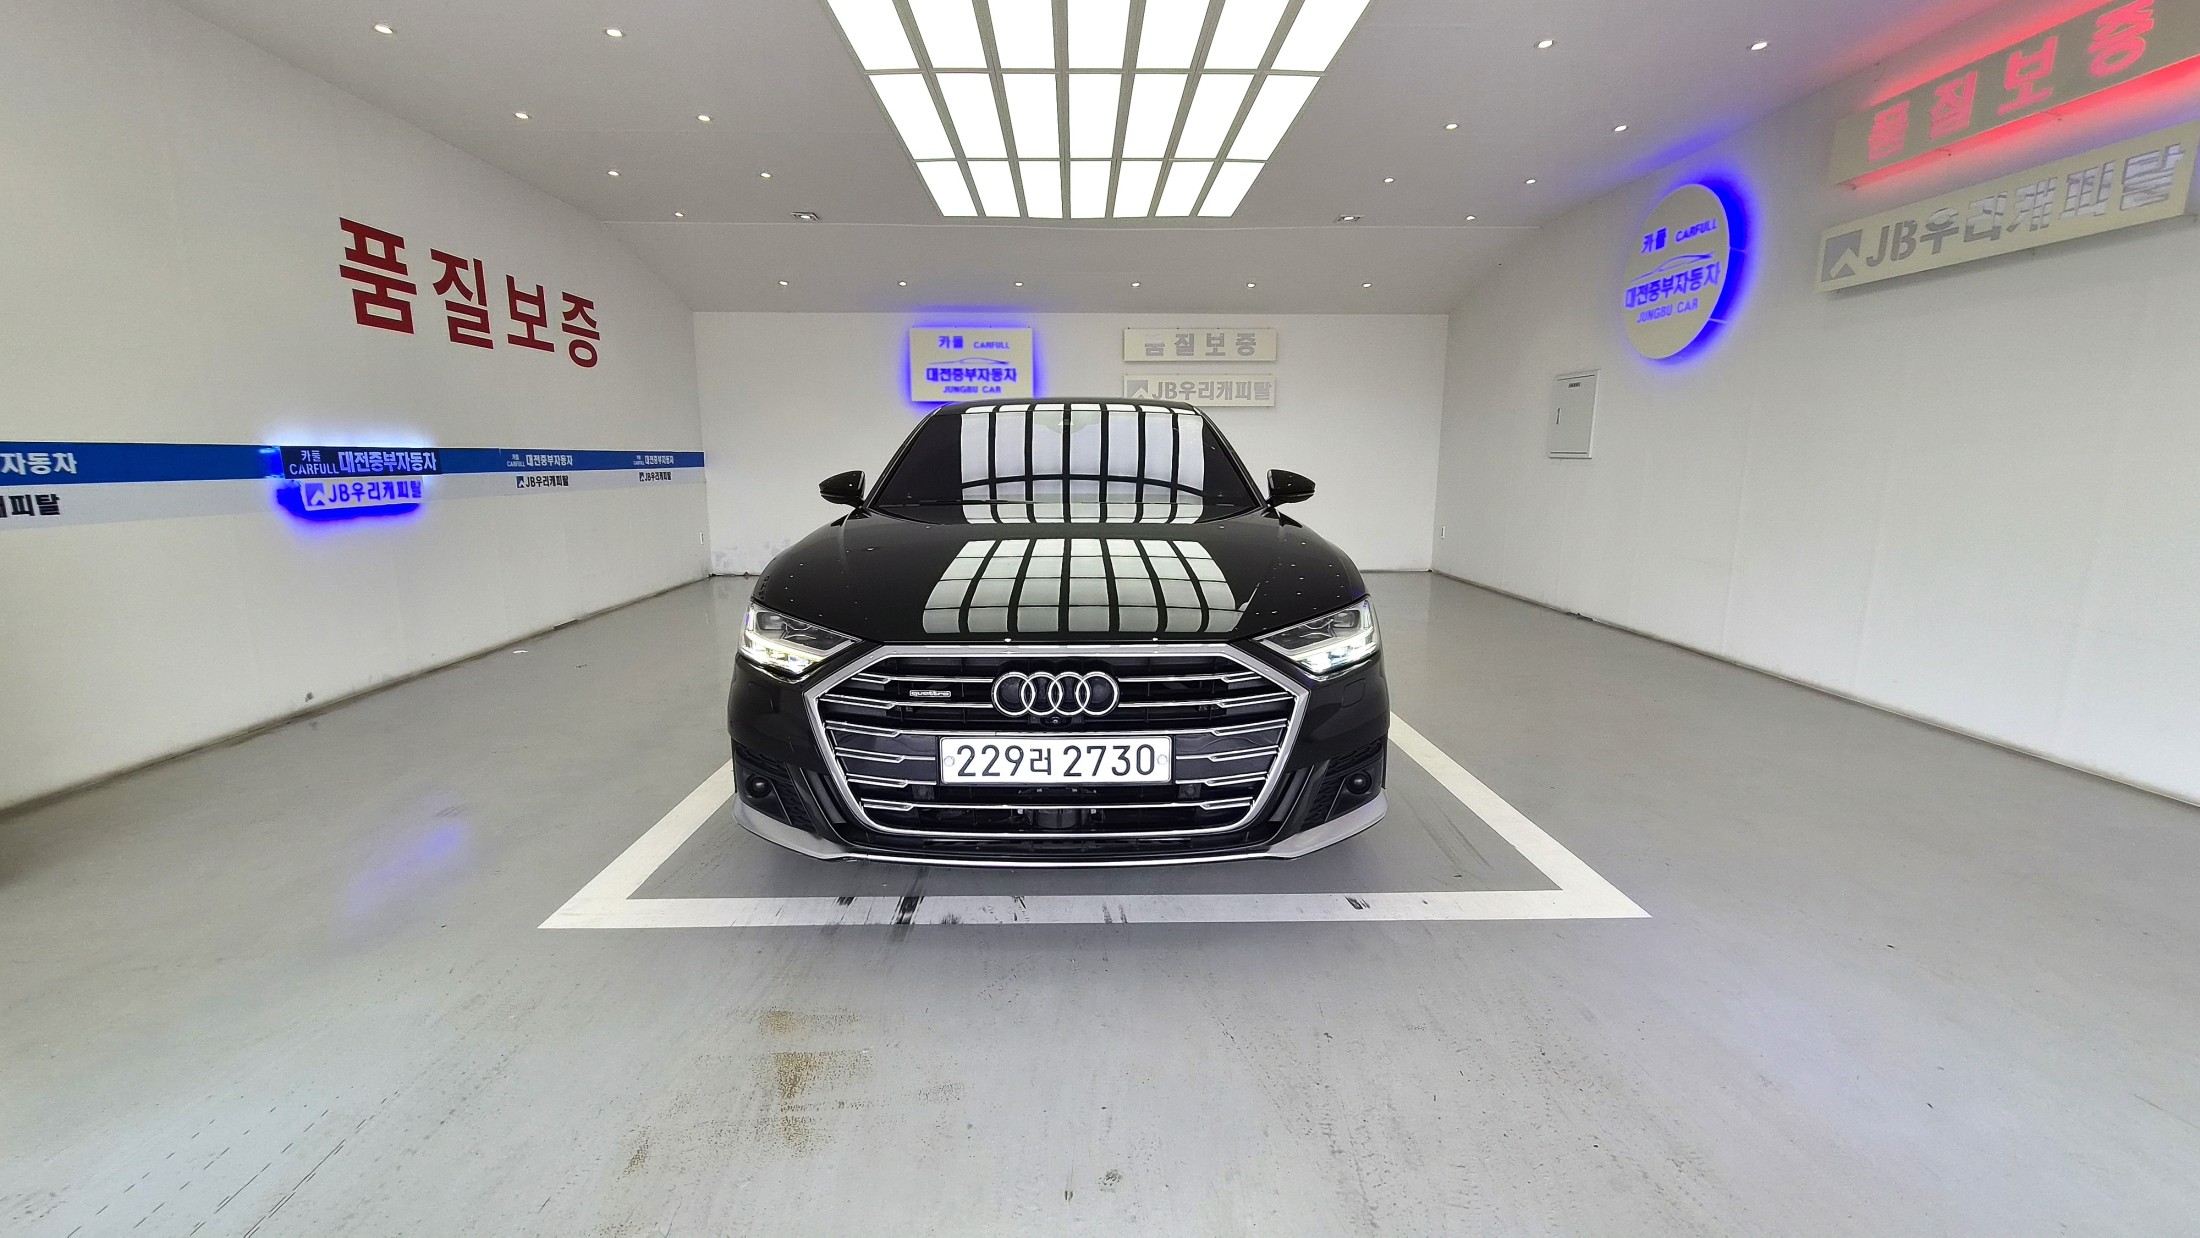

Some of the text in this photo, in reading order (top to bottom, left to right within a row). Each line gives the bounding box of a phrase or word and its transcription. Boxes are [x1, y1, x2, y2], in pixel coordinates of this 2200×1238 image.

[1867, 0, 2154, 163] 품질보증
[1866, 143, 2186, 267] JB우리캐피탈
[1676, 219, 1718, 242] CARFULL
[339, 216, 600, 369] 품질보증
[1637, 298, 1699, 323] JUNGBU CAR
[973, 341, 1010, 349] CARFULL
[943, 385, 1001, 394] JUNGBU CAR
[1152, 381, 1272, 401] JB우리캐피탈
[289, 463, 339, 475] CARFULL
[338, 451, 437, 472] 대전중부자동차
[328, 480, 422, 503] JB우리캐피탈
[525, 475, 569, 488] JB우리캐피탈
[957, 743, 1155, 777] 229러 2730
